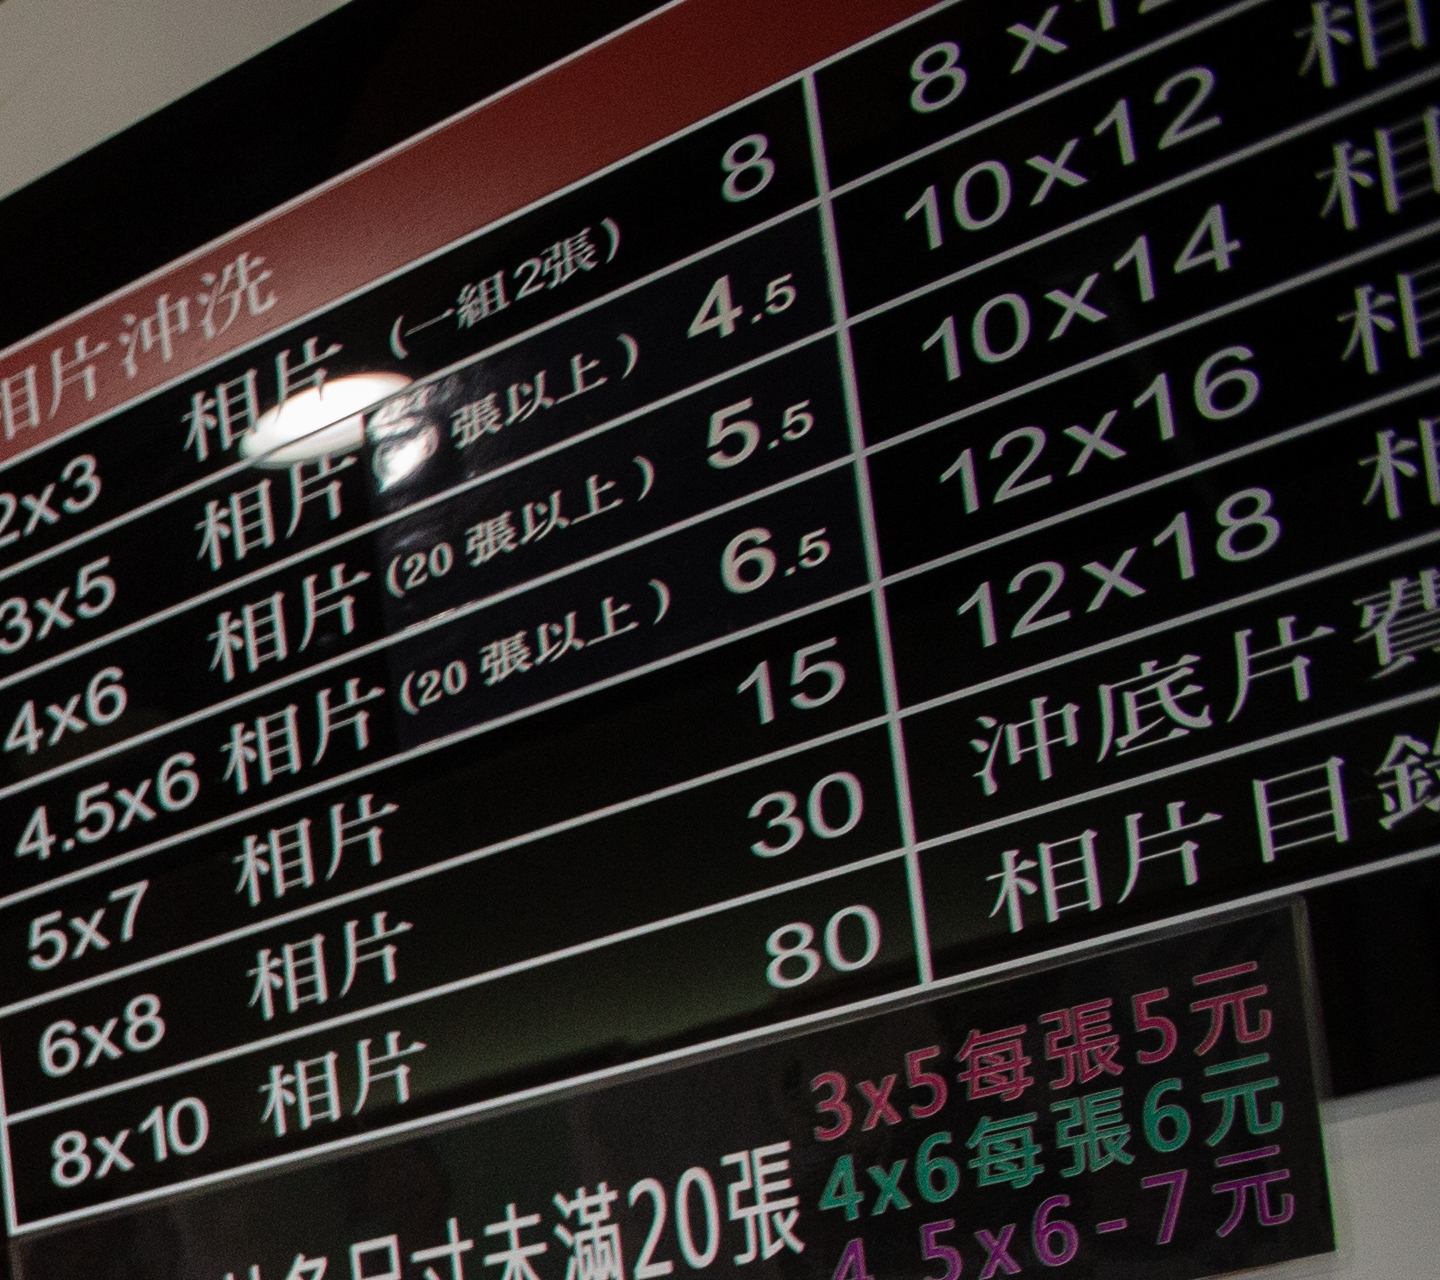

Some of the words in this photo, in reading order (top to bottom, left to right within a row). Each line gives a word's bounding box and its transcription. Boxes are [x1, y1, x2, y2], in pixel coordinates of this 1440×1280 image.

[180, 336, 345, 463] 相片
[720, 133, 776, 203] 8
[904, 65, 1223, 251] 10x12
[920, 202, 1242, 383] 10x14
[194, 452, 359, 571] 相片
[686, 273, 798, 341] 4.5
[938, 344, 1263, 516] 12x16
[957, 486, 1282, 649] 12x18
[2, 666, 130, 757] 4x6
[205, 562, 373, 685] 相片
[706, 398, 815, 470] 5.5
[13, 750, 201, 862] 4.5x6
[218, 677, 386, 794] 相片
[719, 527, 831, 595] 6.5
[25, 879, 152, 972] 5x7
[231, 793, 401, 908] 相片
[736, 636, 848, 725] 15
[37, 993, 167, 1077] 6x8
[245, 911, 414, 1021] 相片
[746, 770, 865, 859] 30
[49, 1094, 210, 1189] 8x10
[258, 1029, 427, 1137] 相片
[763, 903, 883, 990] 80
